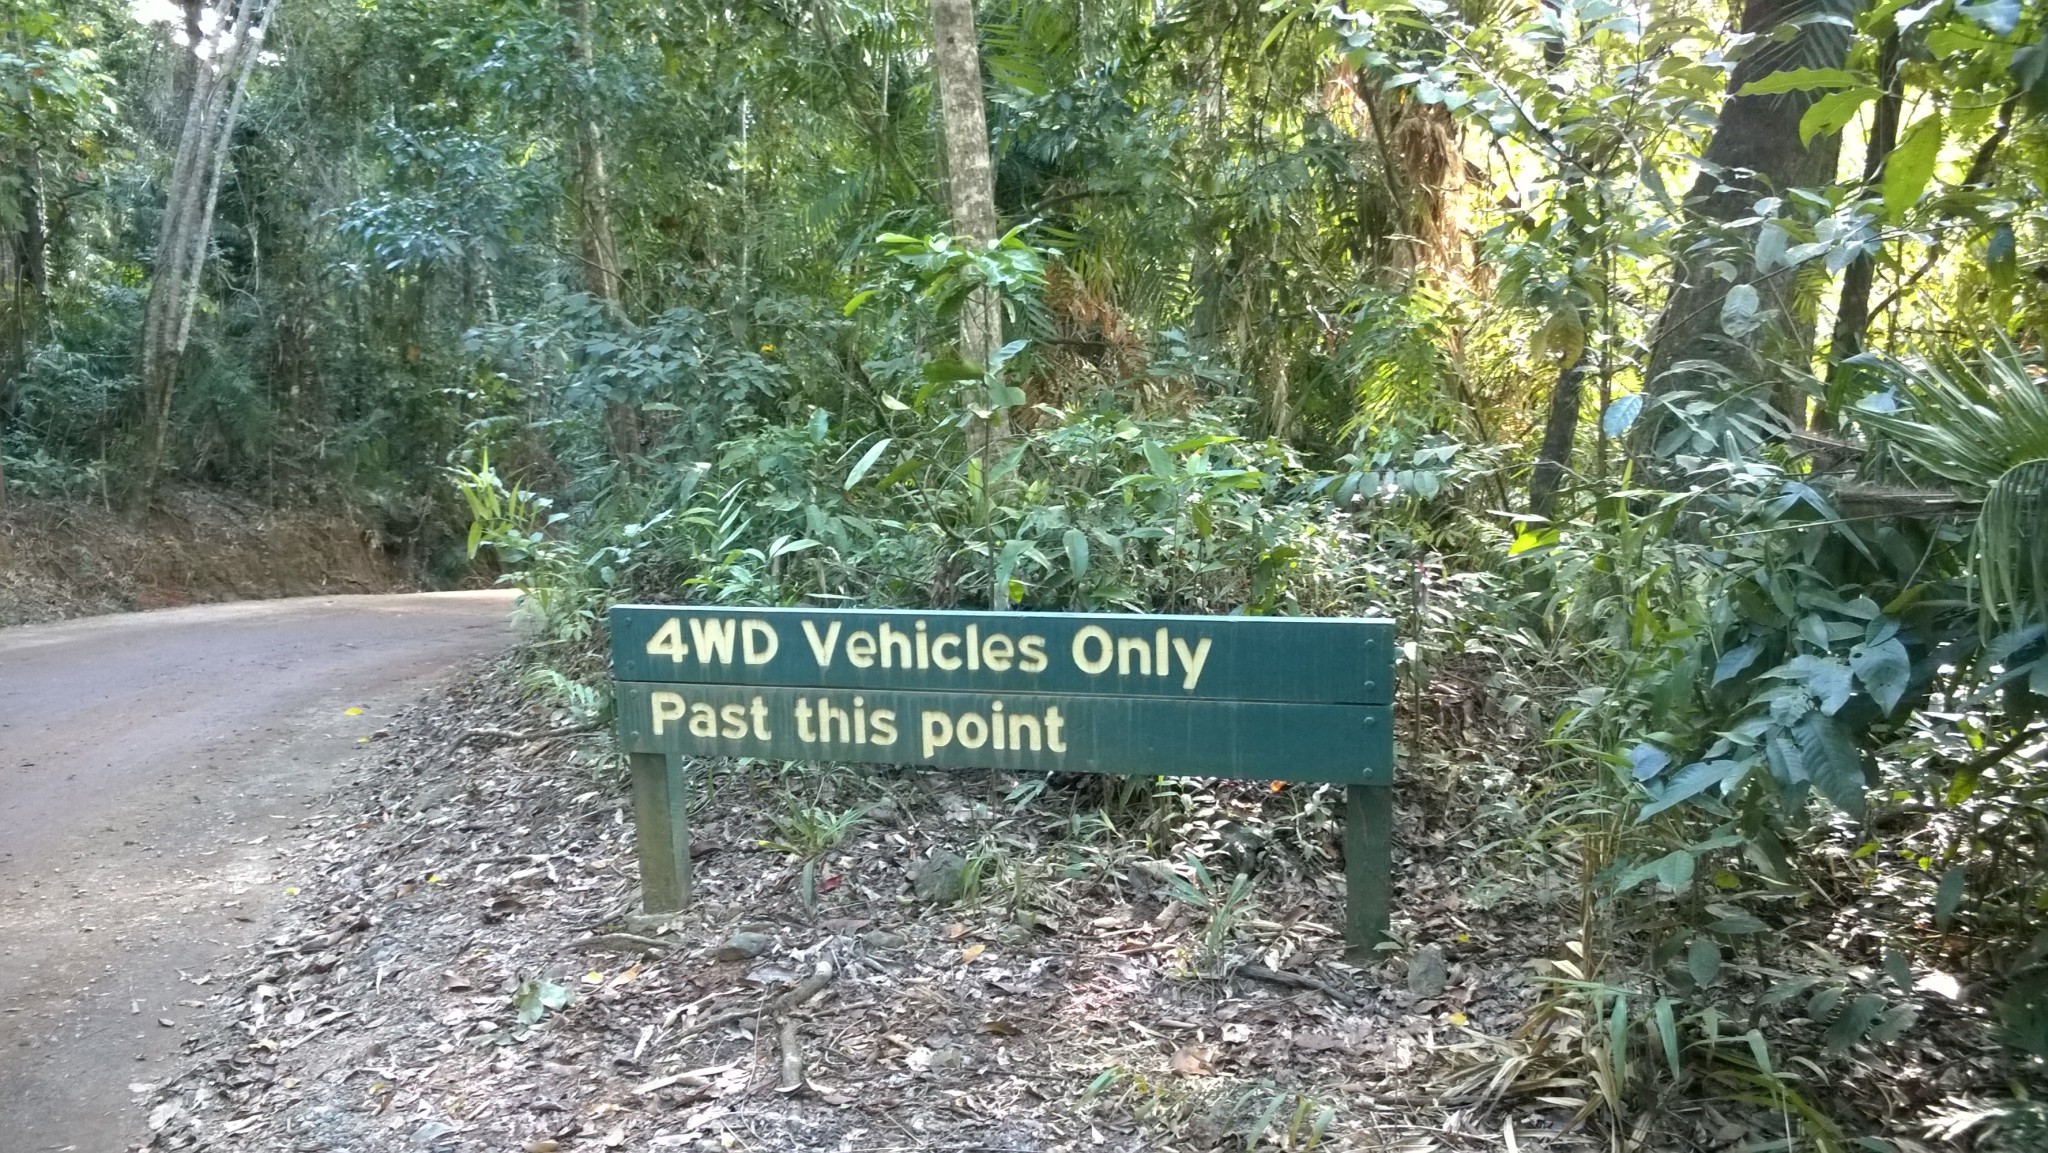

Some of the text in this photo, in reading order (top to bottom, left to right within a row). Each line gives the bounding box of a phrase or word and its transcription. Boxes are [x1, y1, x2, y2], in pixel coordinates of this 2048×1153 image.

[646, 618, 1213, 690] 4WD Vehicles Only
[650, 690, 1067, 760] Past this point
